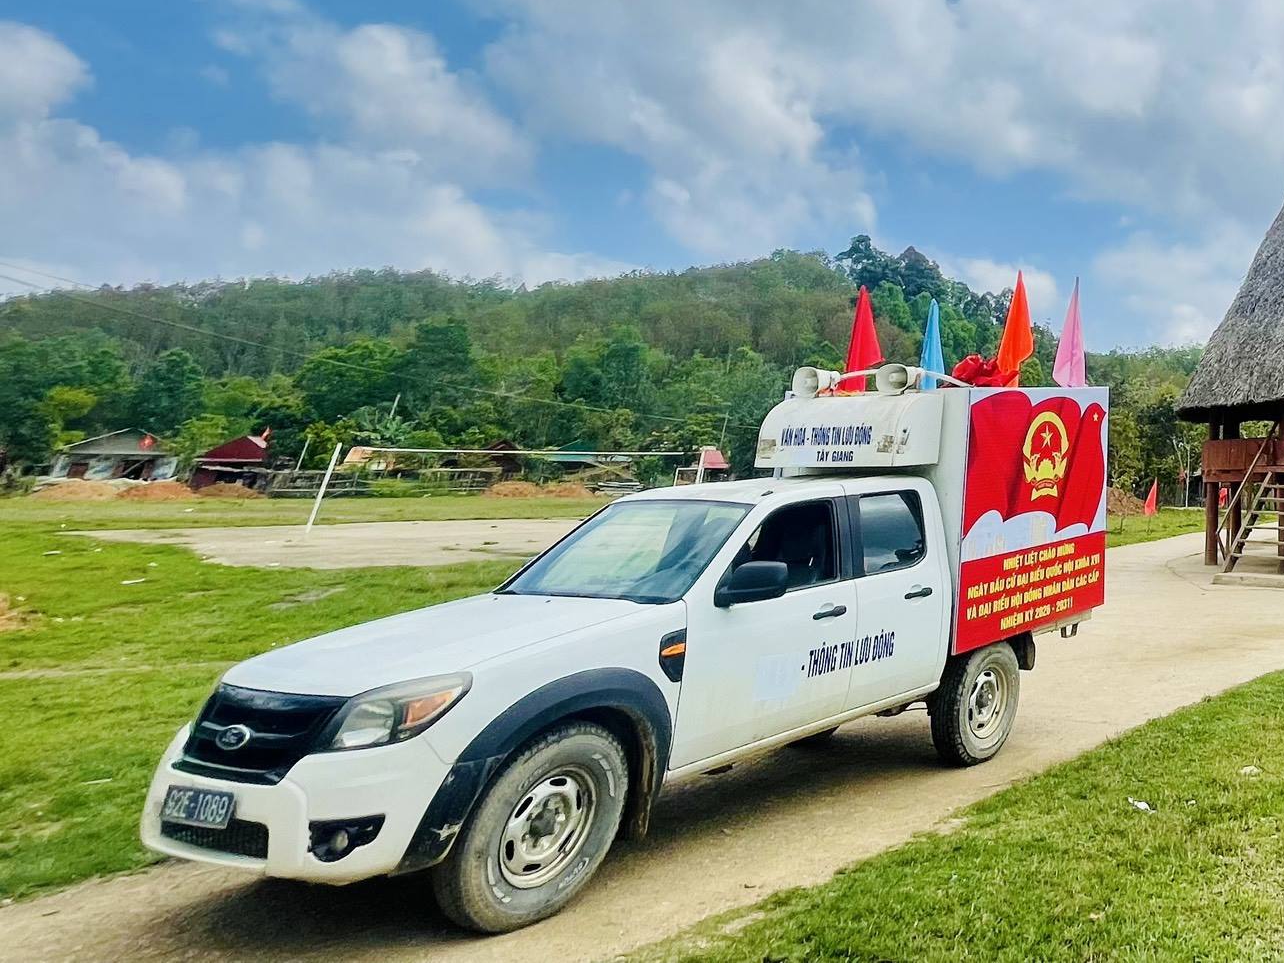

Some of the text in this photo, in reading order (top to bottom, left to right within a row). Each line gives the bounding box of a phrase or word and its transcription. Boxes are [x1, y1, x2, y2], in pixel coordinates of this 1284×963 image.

[831, 427, 841, 445] TIN
[817, 449, 853, 461] TÂY GIANG
[967, 581, 989, 599] NGÀY
[967, 607, 977, 620] VÀ
[807, 641, 838, 678] THÔNG
[839, 641, 854, 670] TIN
[854, 635, 872, 665] LƯU
[871, 629, 895, 661] ĐỘNG
[165, 789, 229, 824] 92E-1089
